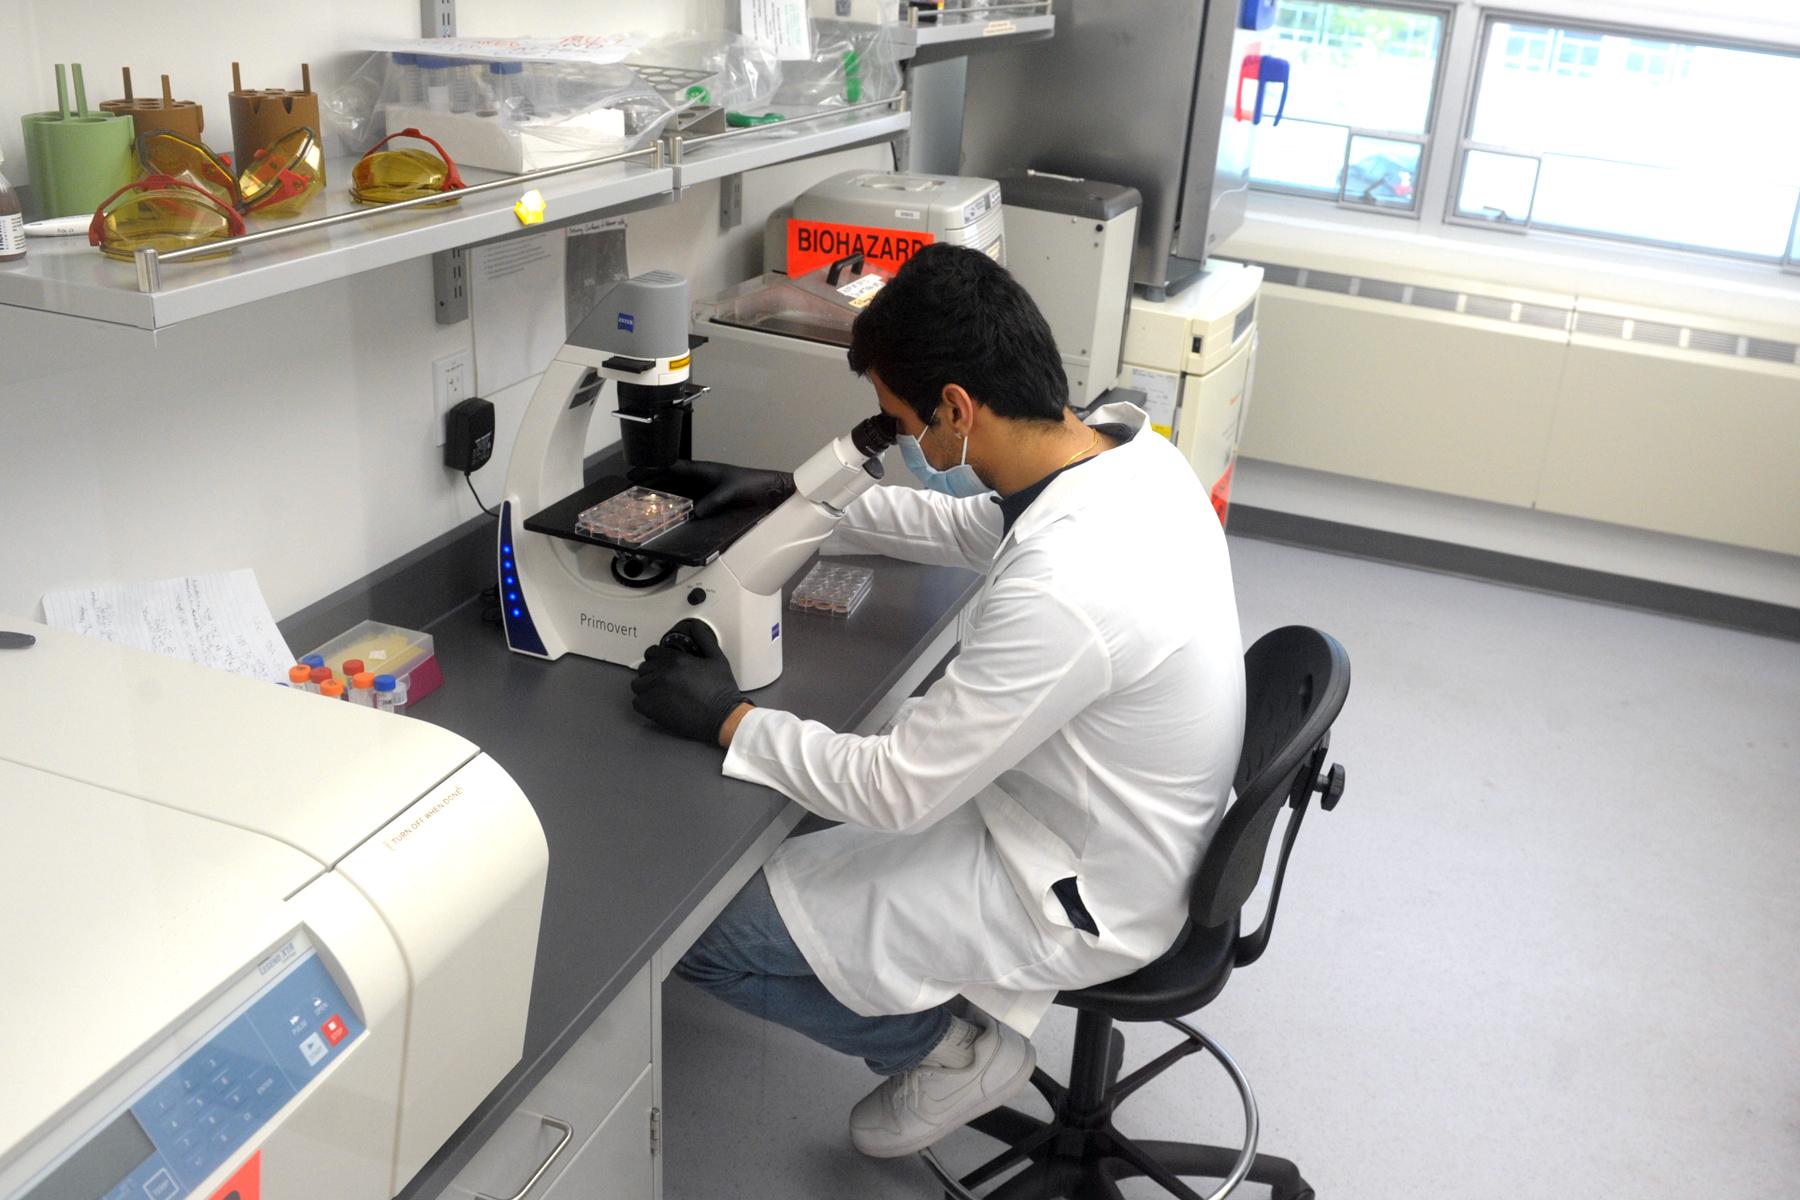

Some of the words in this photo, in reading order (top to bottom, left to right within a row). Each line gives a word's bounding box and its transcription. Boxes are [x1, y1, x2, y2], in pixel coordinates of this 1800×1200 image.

[580, 613, 638, 638] Primovert
[391, 828, 413, 845] TURN
[410, 817, 424, 830] OFF
[424, 803, 445, 820] WHEN
